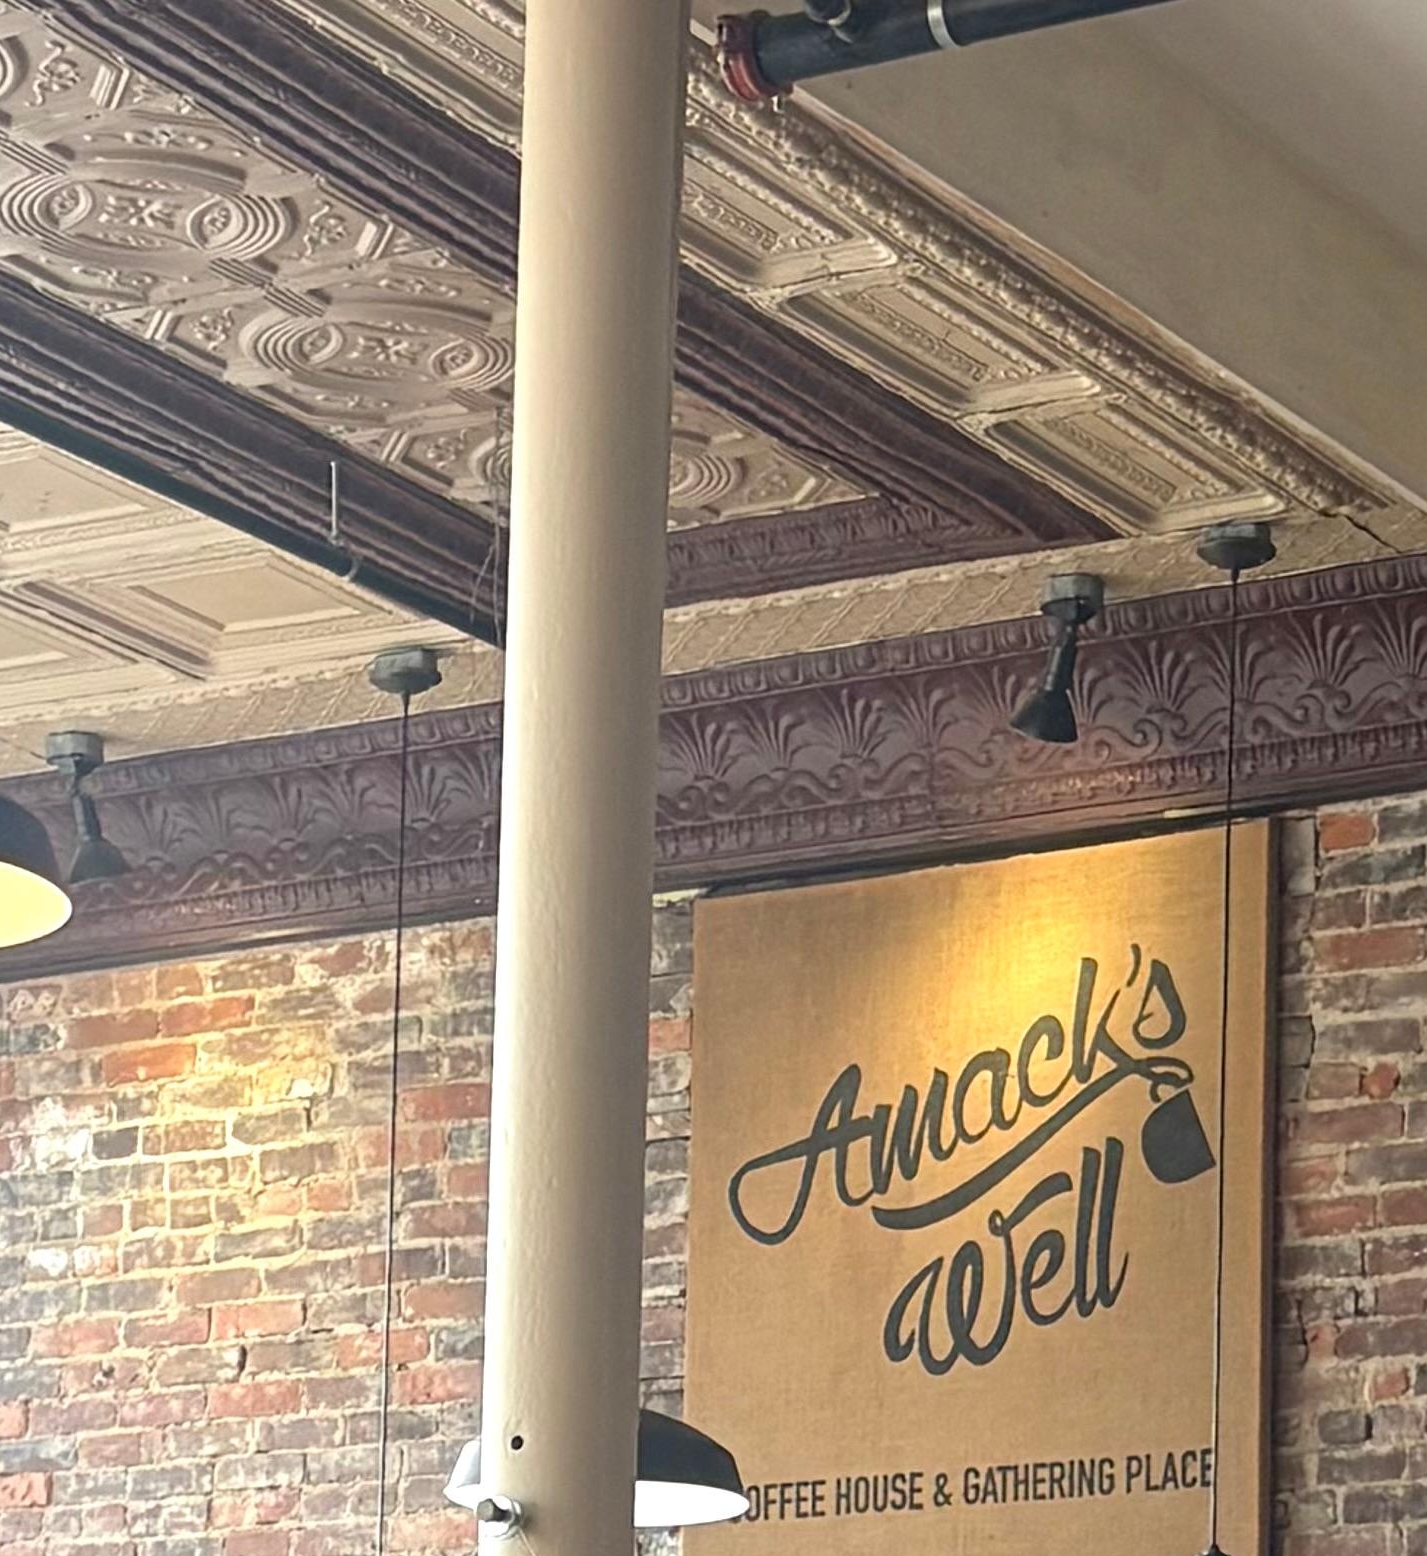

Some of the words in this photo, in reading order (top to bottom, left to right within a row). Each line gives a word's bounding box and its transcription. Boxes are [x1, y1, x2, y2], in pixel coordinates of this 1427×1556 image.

[727, 942, 1187, 1246] Amack's
[883, 1136, 1130, 1375] Well
[731, 1480, 826, 1523] OFFEE
[835, 1472, 924, 1515] HOUSE
[934, 1478, 953, 1506] &
[963, 1457, 1116, 1505] GATHERING
[1125, 1448, 1213, 1494] PLACE
